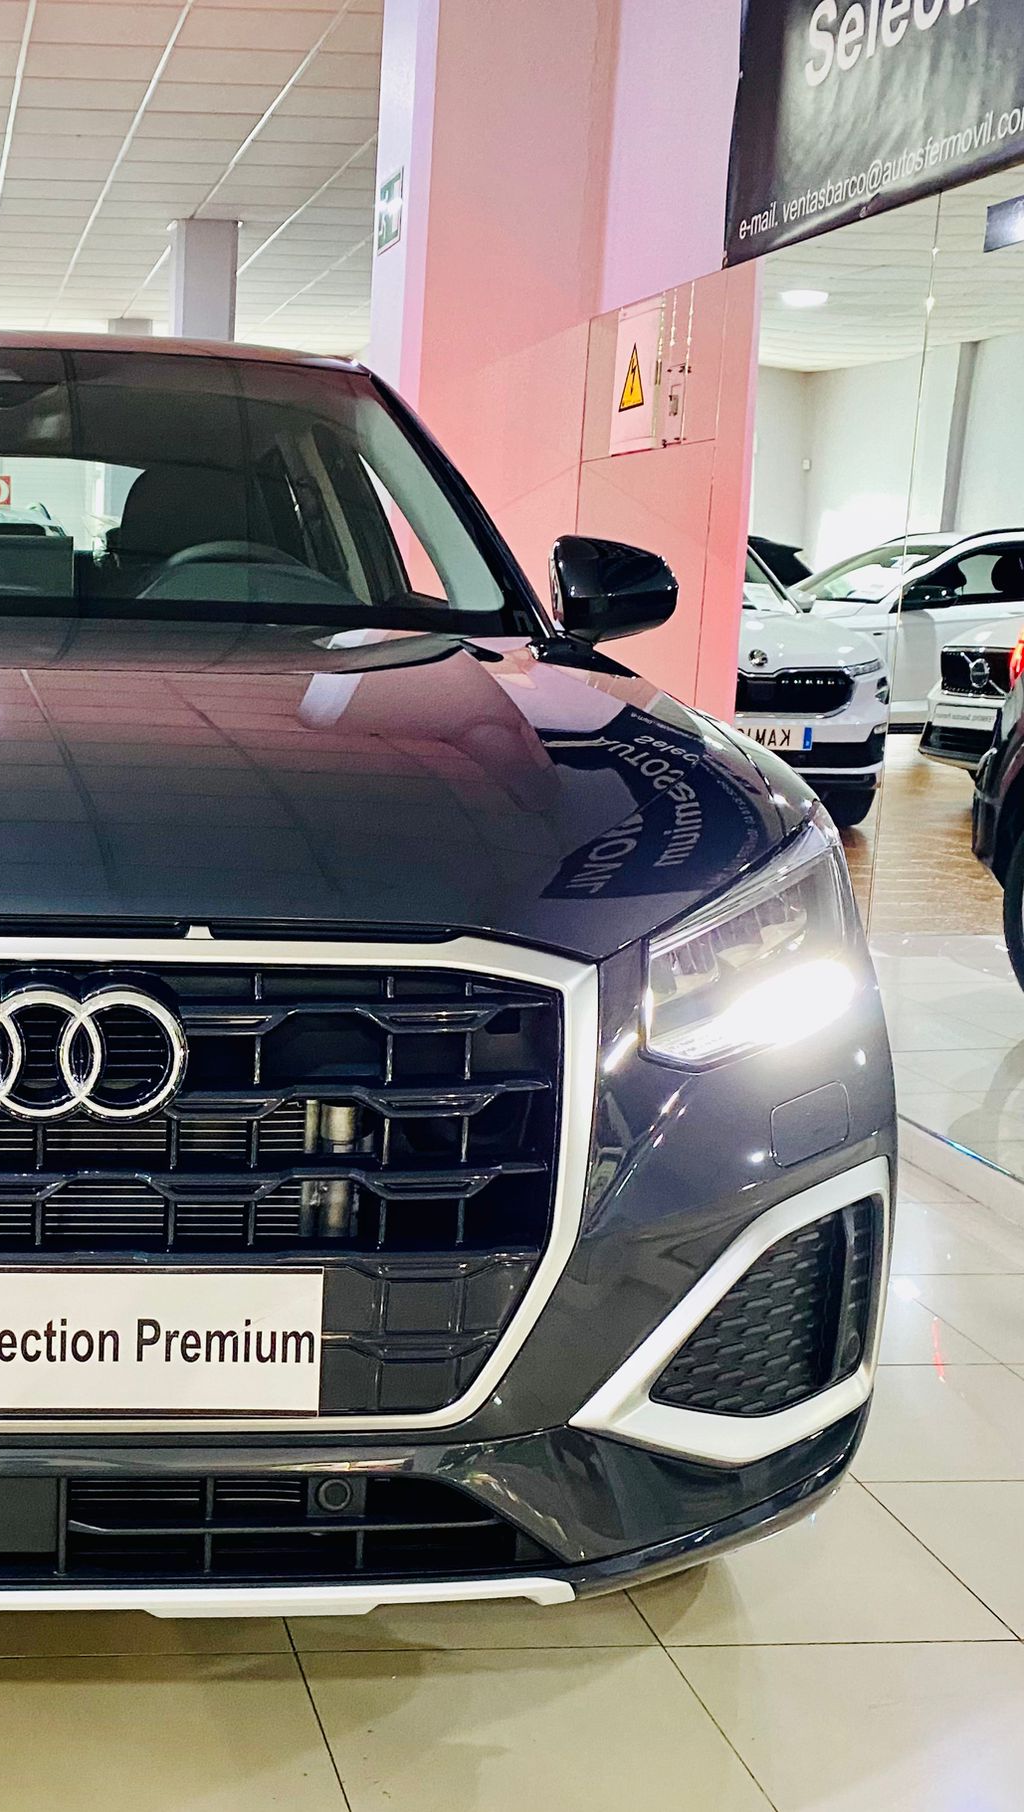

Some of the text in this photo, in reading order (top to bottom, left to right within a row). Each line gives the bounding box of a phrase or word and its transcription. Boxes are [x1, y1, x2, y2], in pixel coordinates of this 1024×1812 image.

[805, 0, 979, 87] Sele
[782, 106, 1024, 224] ventasbarco@autosfermovil.co
[137, 1318, 316, 1364] Premium
